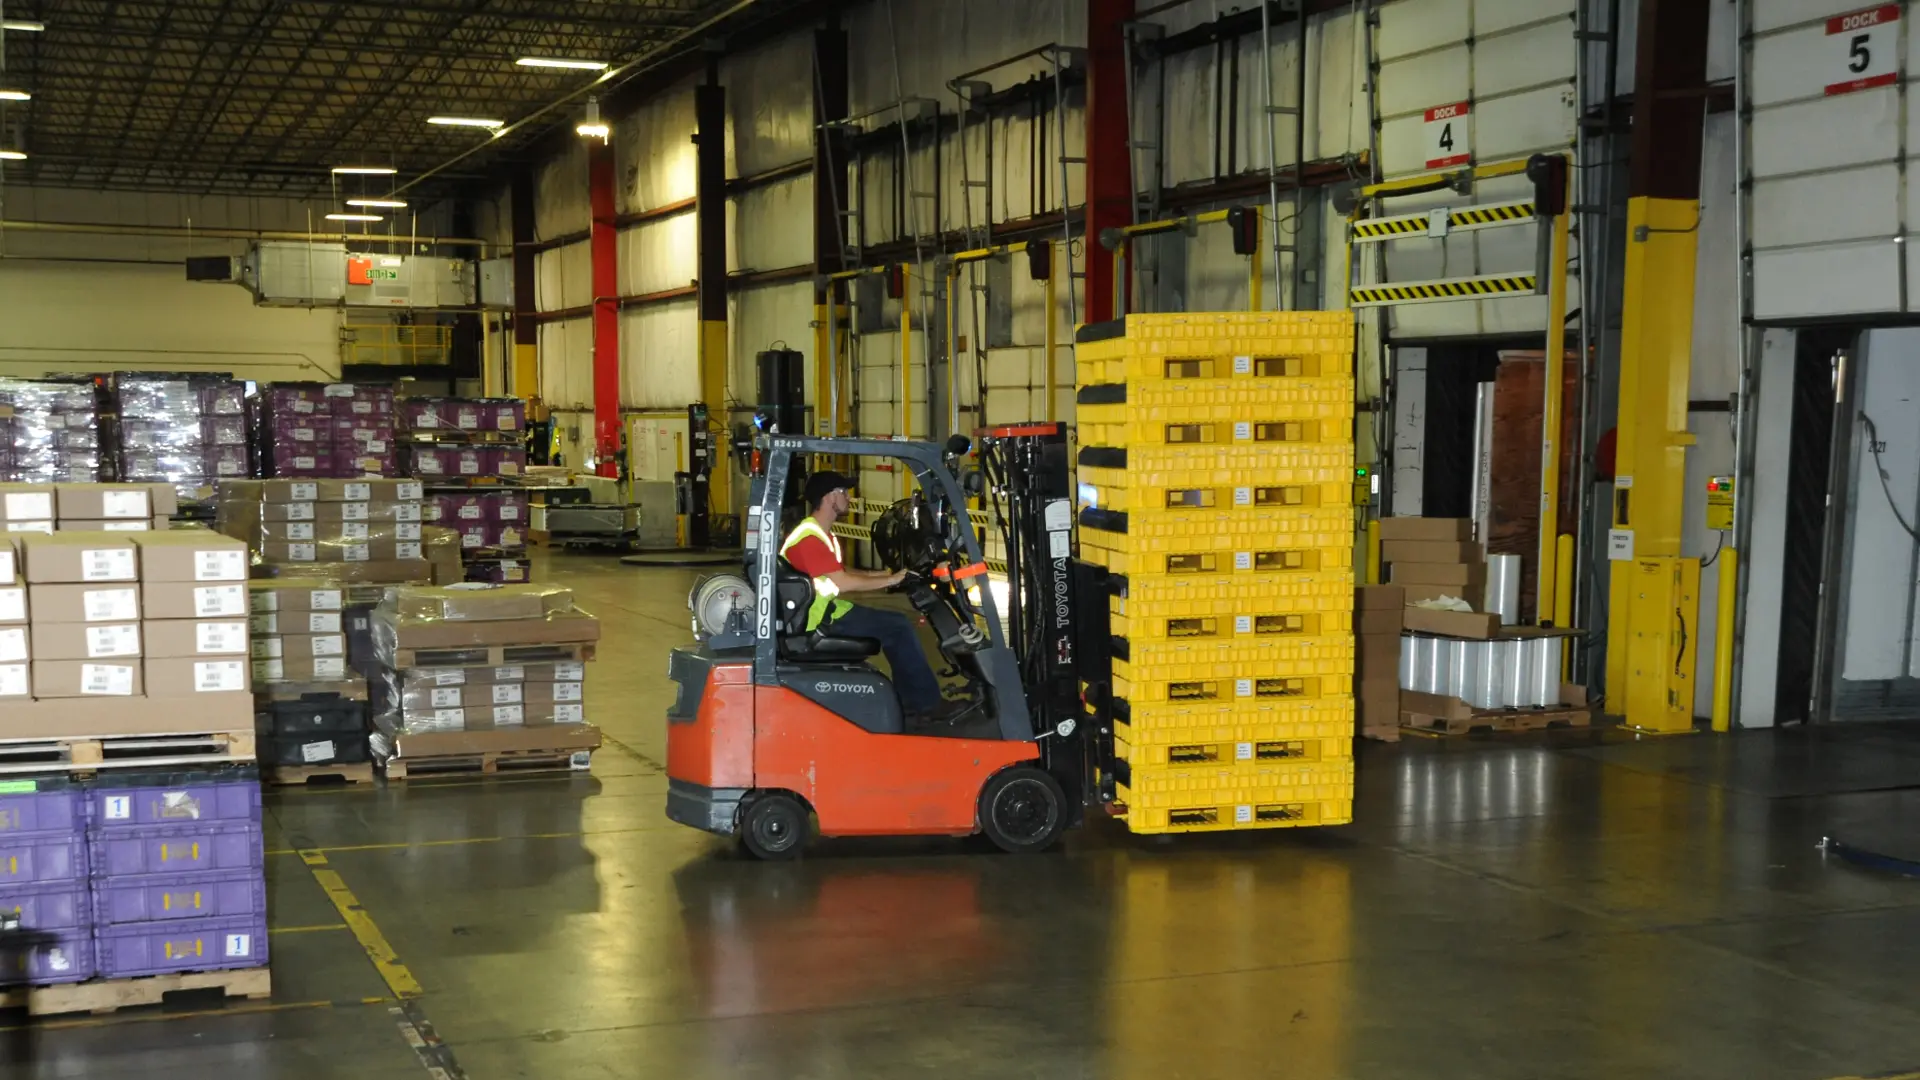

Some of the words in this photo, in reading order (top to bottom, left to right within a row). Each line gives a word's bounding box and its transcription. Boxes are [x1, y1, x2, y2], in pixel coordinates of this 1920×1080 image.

[1841, 10, 1880, 30] DOCK
[1848, 33, 1870, 73] 5
[1434, 105, 1456, 120] DOCK
[1439, 122, 1453, 152] 4
[1053, 556, 1070, 629] TOYOTA
[832, 683, 875, 694] TOYOTA
[113, 798, 121, 813] 1
[234, 936, 241, 950] 1
